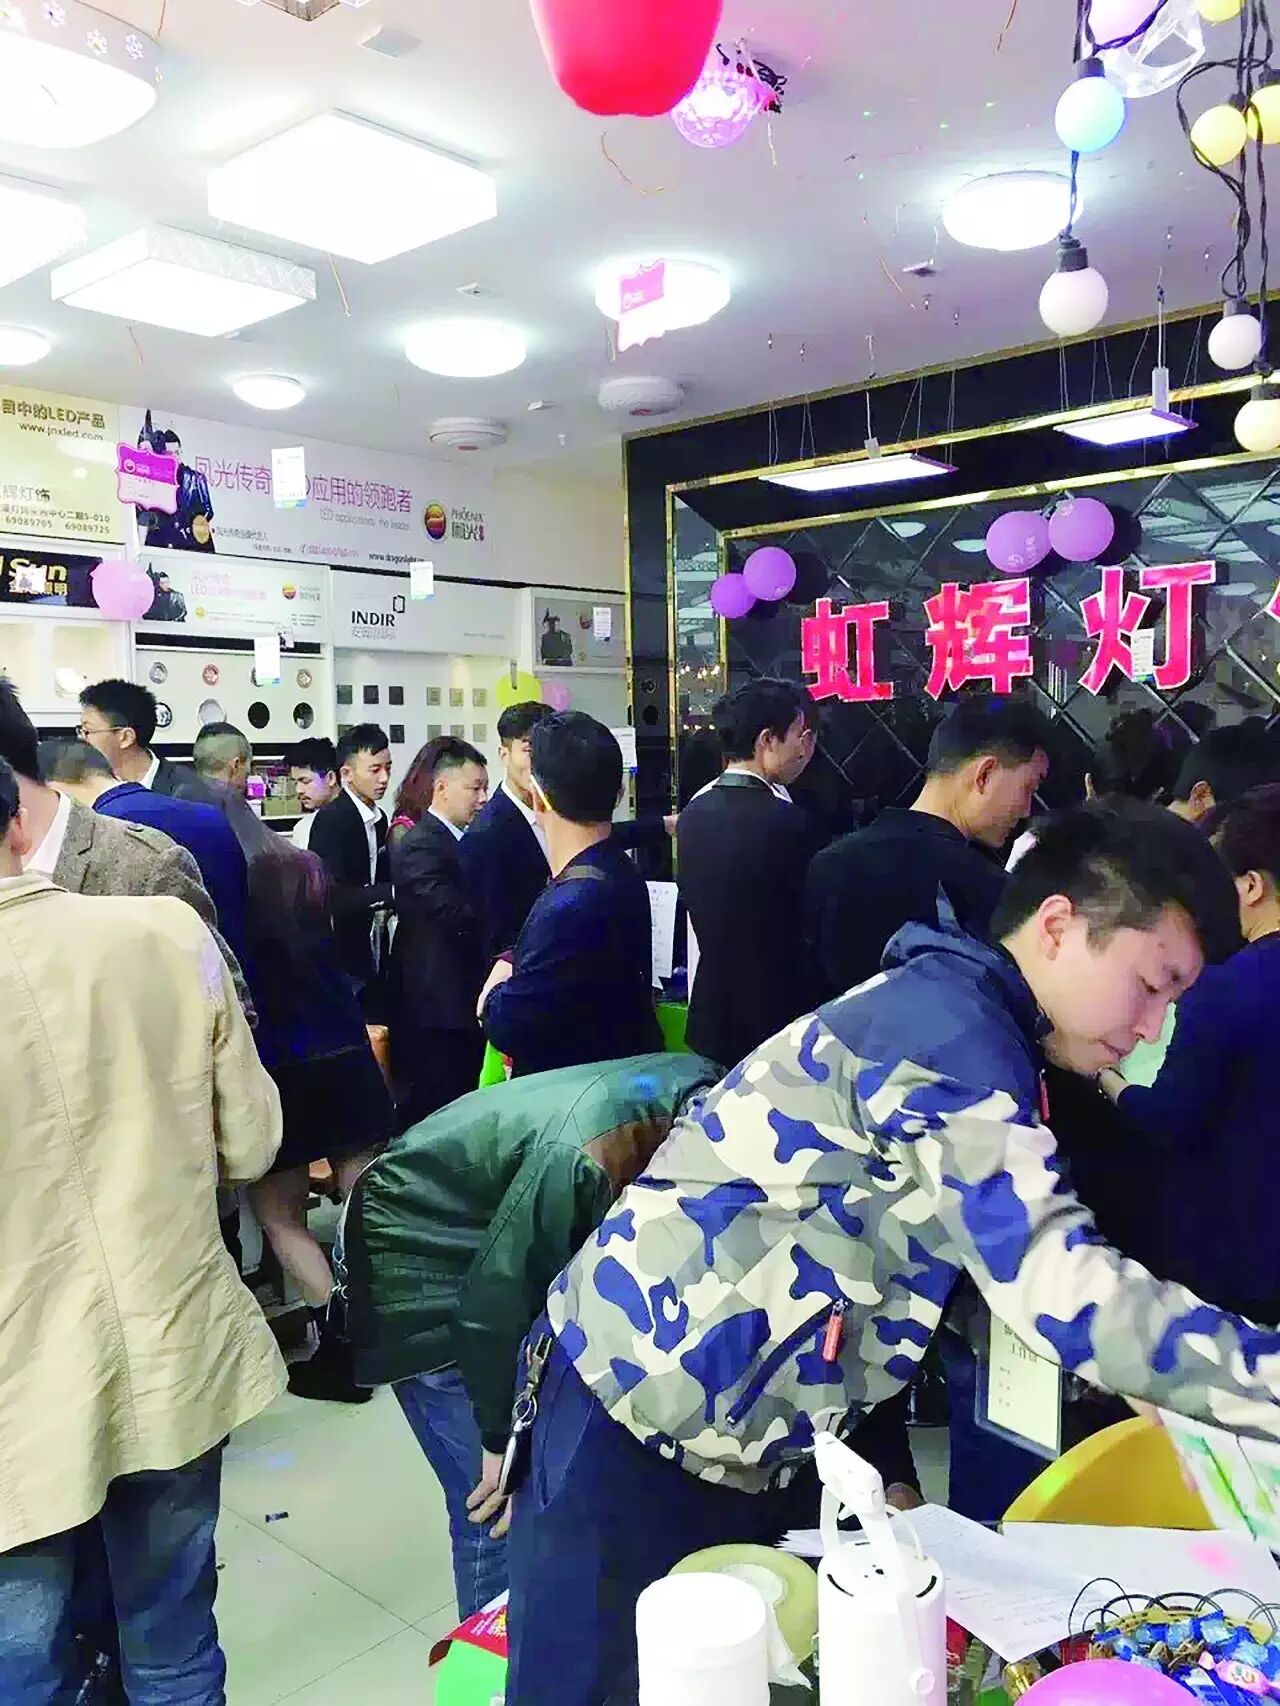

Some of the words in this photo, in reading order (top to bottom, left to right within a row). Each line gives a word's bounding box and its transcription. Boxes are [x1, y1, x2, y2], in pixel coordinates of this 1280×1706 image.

[351, 610, 396, 628] INDIR
[801, 560, 1280, 702] 虹辉灯
